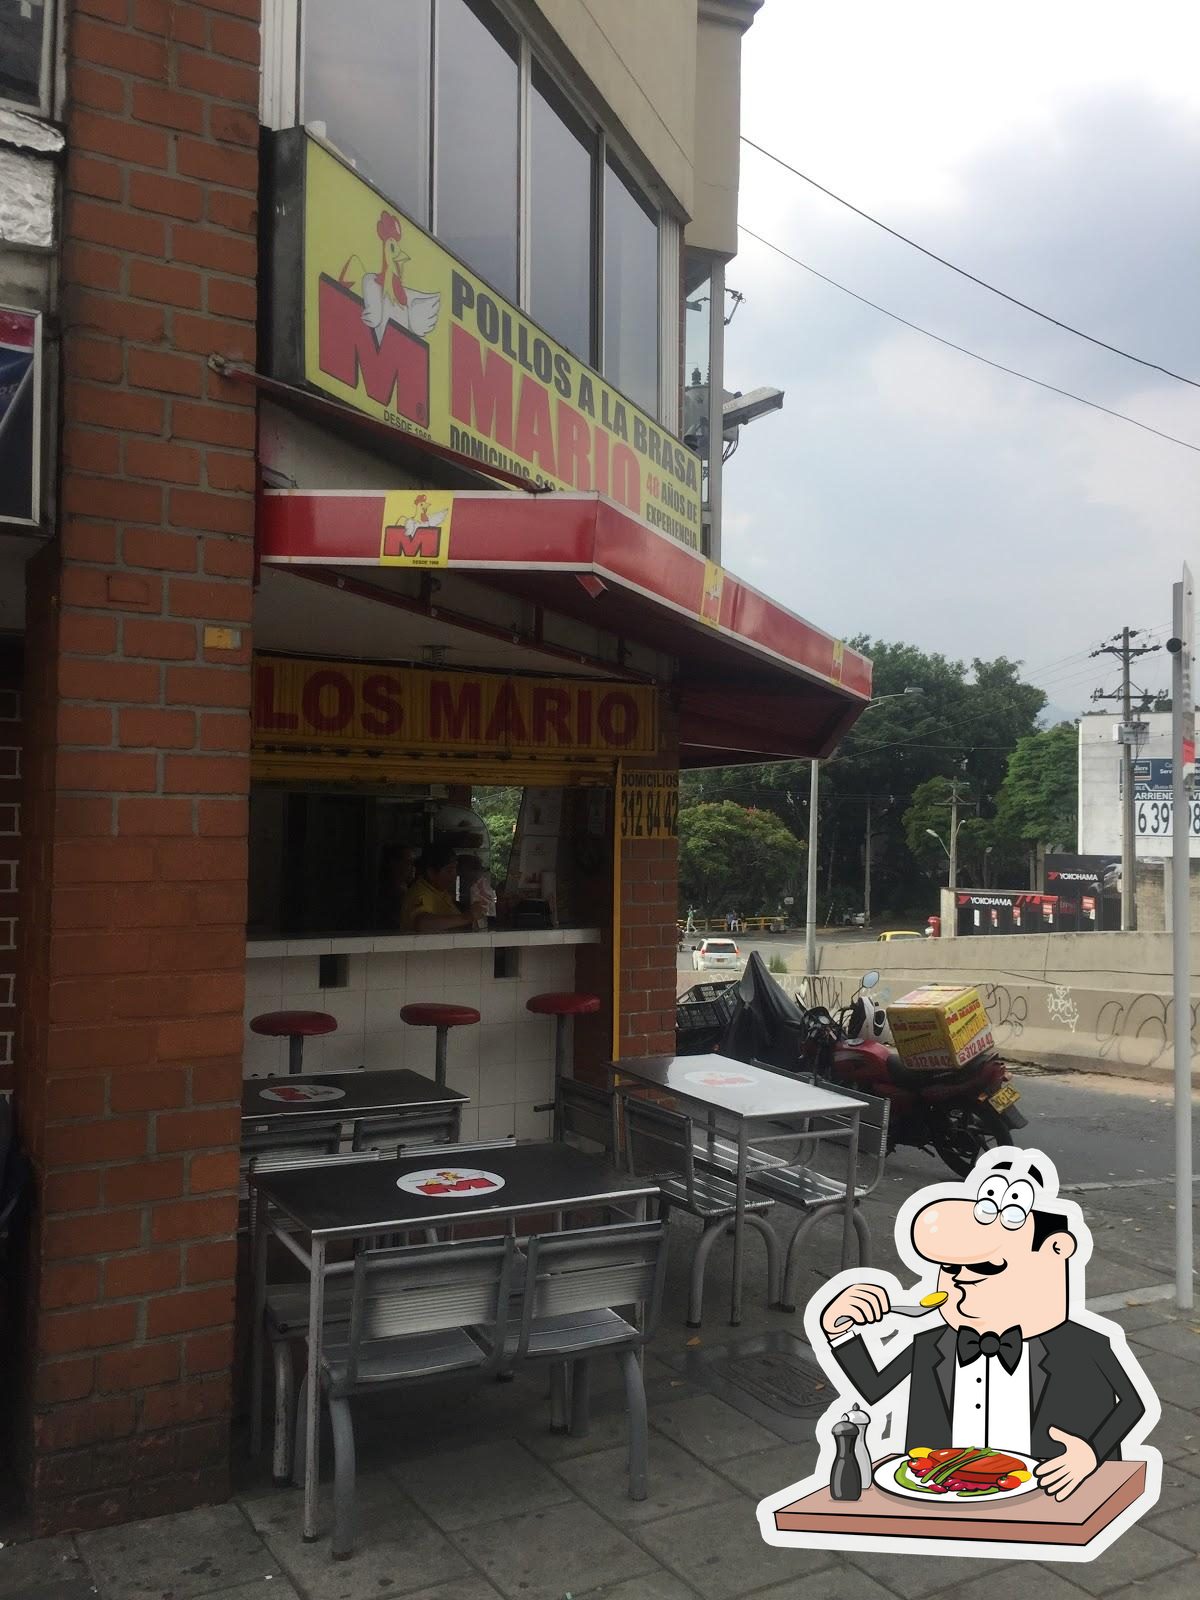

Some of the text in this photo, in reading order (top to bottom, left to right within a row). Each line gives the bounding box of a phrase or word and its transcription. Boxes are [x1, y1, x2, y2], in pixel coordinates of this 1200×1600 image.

[452, 269, 697, 494] POLLOS A LA BRASA
[451, 321, 641, 516] MARIO
[646, 502, 698, 551] EXPERIENCIA
[687, 500, 698, 524] DE
[429, 678, 640, 746] MARIO
[622, 773, 679, 788] DOMICILIOS
[1059, 872, 1098, 881] YOKOHAMA
[970, 896, 1012, 906] YOKOHAMA
